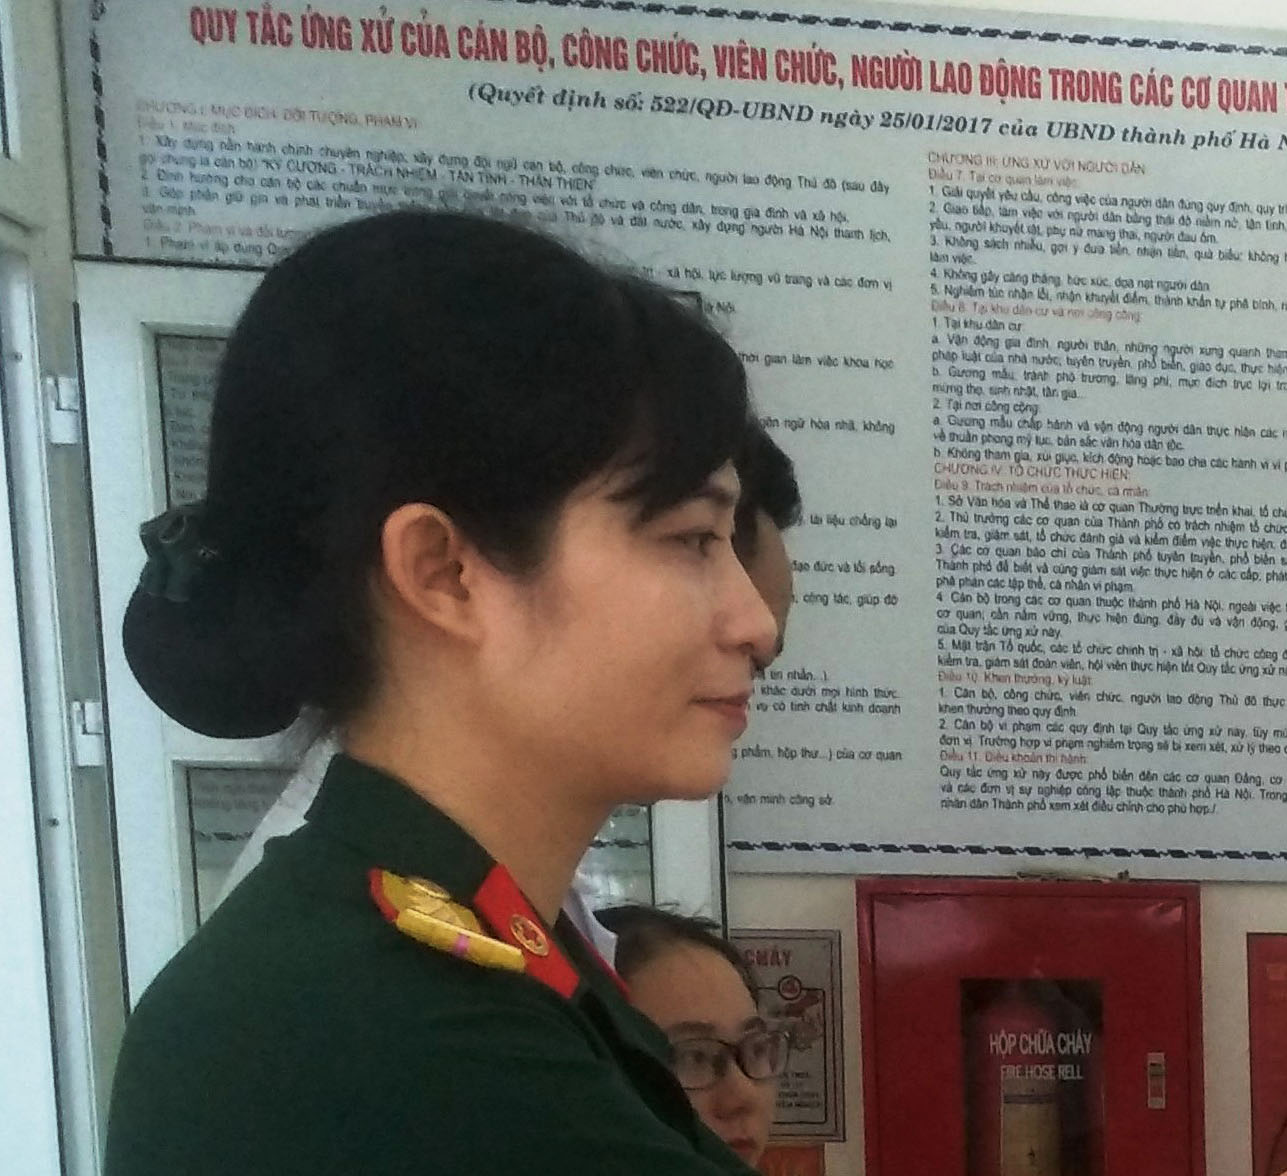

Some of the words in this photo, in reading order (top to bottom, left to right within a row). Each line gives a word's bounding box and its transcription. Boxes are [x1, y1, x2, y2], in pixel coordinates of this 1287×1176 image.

[190, 6, 237, 46] QUY
[246, 1, 292, 47] TẮC
[361, 5, 394, 55] XỬ
[400, 8, 450, 58] CỦA
[457, 20, 508, 61] CÁN
[515, 24, 555, 72] BỘ,
[563, 27, 628, 71] CÔNG
[636, 30, 707, 80] CHỨC,
[713, 38, 767, 81] VIÊN
[775, 41, 844, 89] CHỨC,
[852, 47, 922, 92] NGƯỜI
[930, 61, 971, 95] LAO
[979, 58, 1041, 105] ĐỘNG
[1048, 69, 1121, 103] TRONG
[1128, 66, 1172, 107] CÁC
[1180, 74, 1211, 109] CƠ
[1217, 78, 1277, 116] QUAN
[469, 82, 545, 108] (Quyết
[552, 87, 606, 112] định
[614, 88, 645, 110] số:
[650, 97, 814, 121] 522/QĐ-UBND
[819, 108, 874, 129] ngày
[879, 112, 993, 134] 25/01/2017
[999, 118, 1037, 138] của
[1046, 123, 1115, 142] UBND
[1120, 125, 1185, 145] thành
[1190, 128, 1235, 151] phố
[1238, 131, 1269, 150] Hà
[989, 1030, 1016, 1059] HỘP
[1019, 1029, 1055, 1055] CHỮA
[1057, 1029, 1092, 1055] CHÁY
[1025, 1064, 1055, 1080] HOSE
